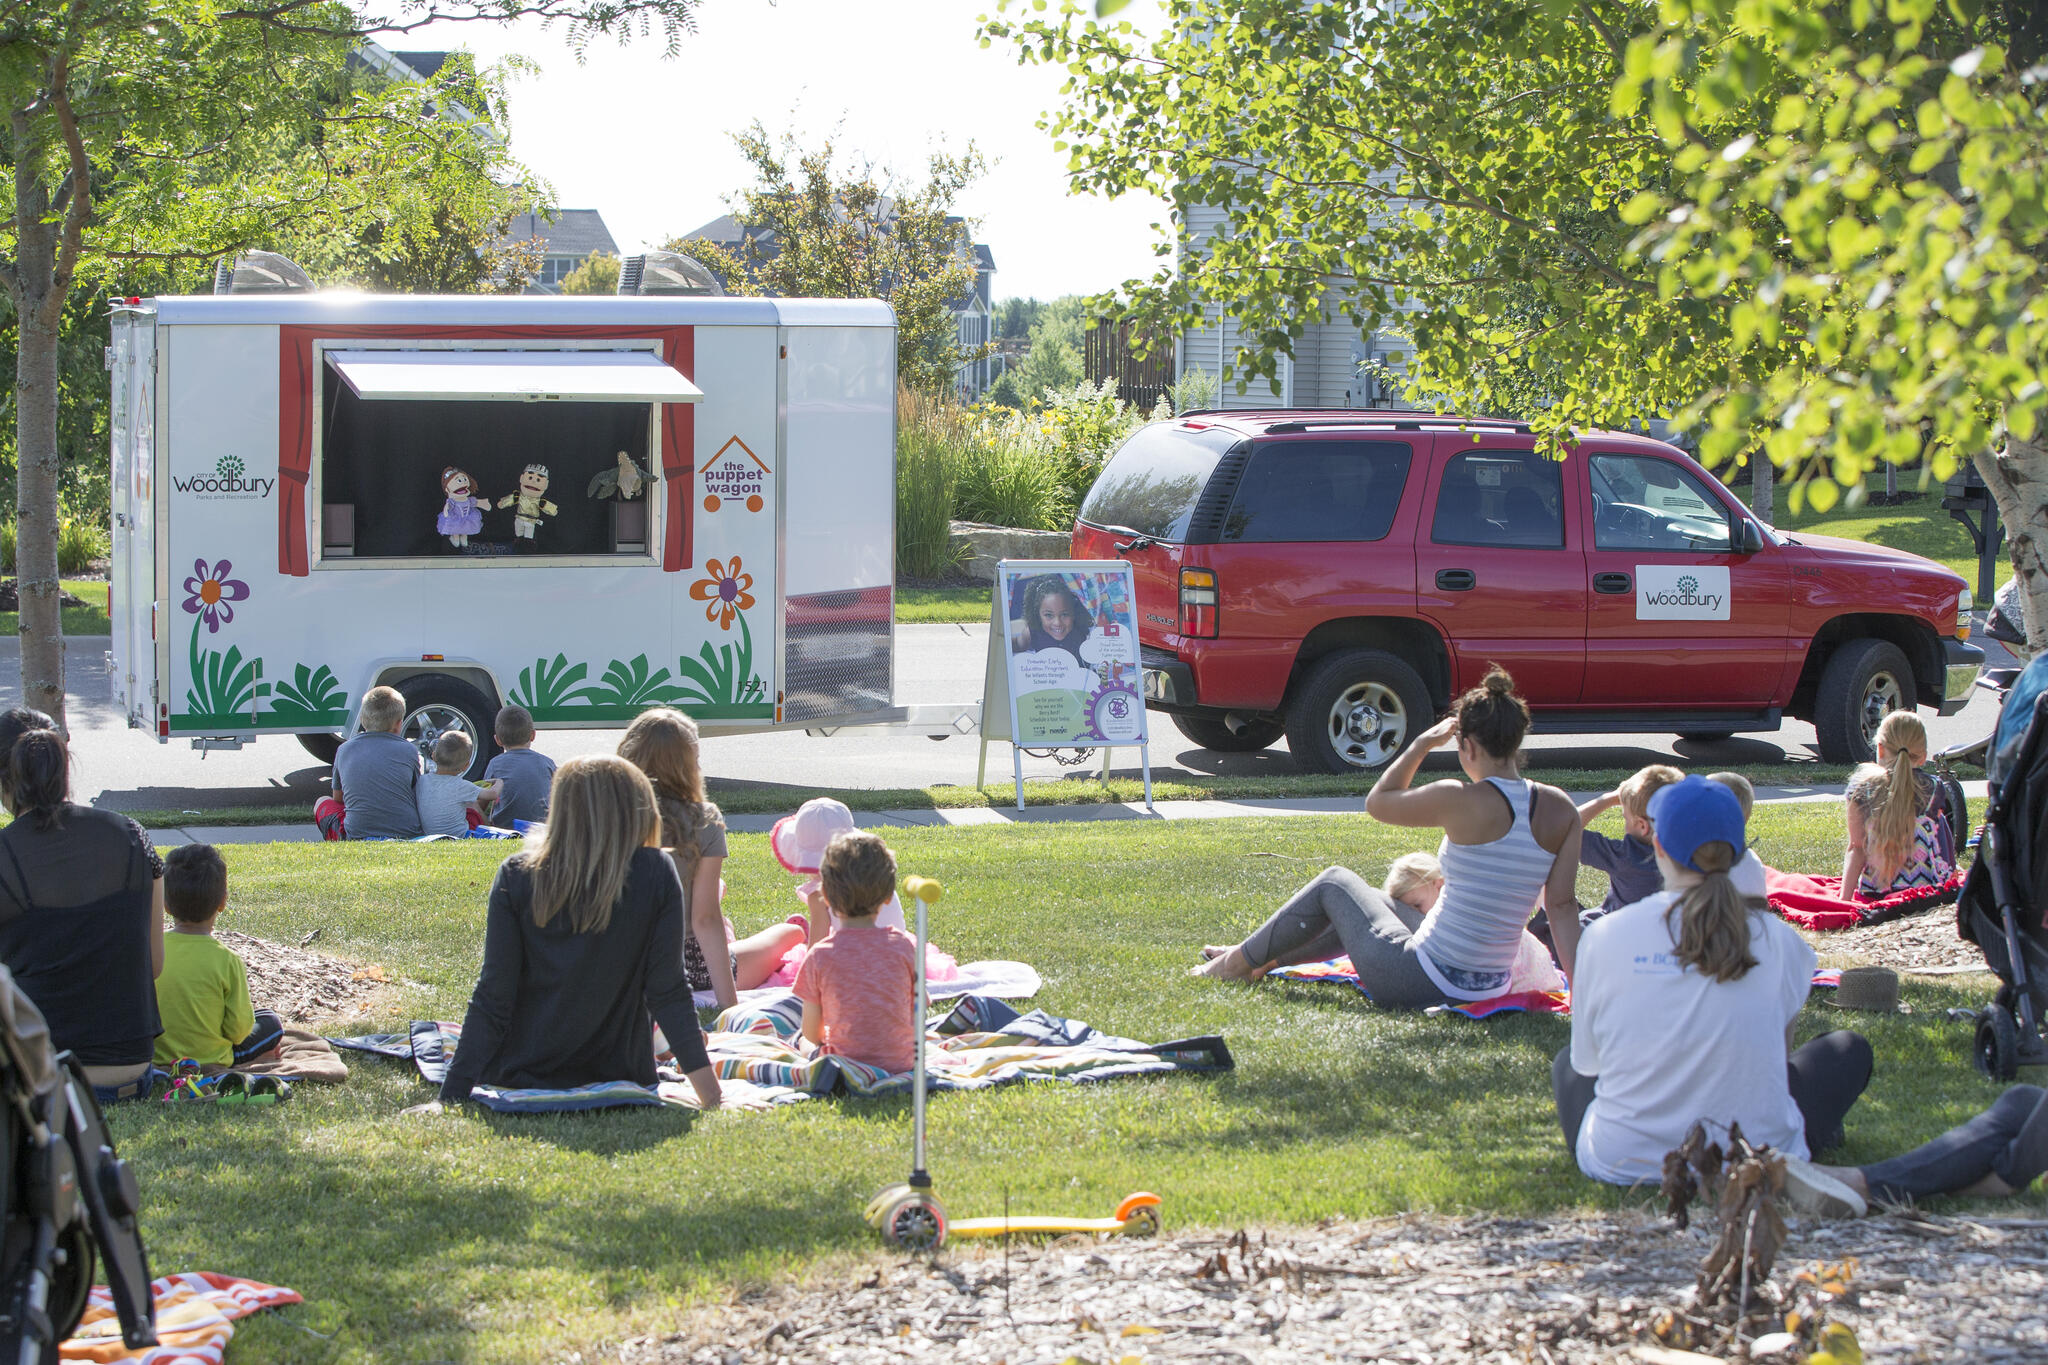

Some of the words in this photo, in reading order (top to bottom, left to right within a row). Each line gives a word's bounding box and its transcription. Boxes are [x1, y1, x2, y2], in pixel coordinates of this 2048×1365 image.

[723, 461, 744, 471] the
[705, 468, 763, 483] puppet
[173, 469, 275, 498] Woodbury
[706, 484, 761, 496] wagon
[1645, 586, 1722, 611] Woodbury
[1146, 613, 1175, 627] CHEVROLET
[738, 680, 767, 692] 1521
